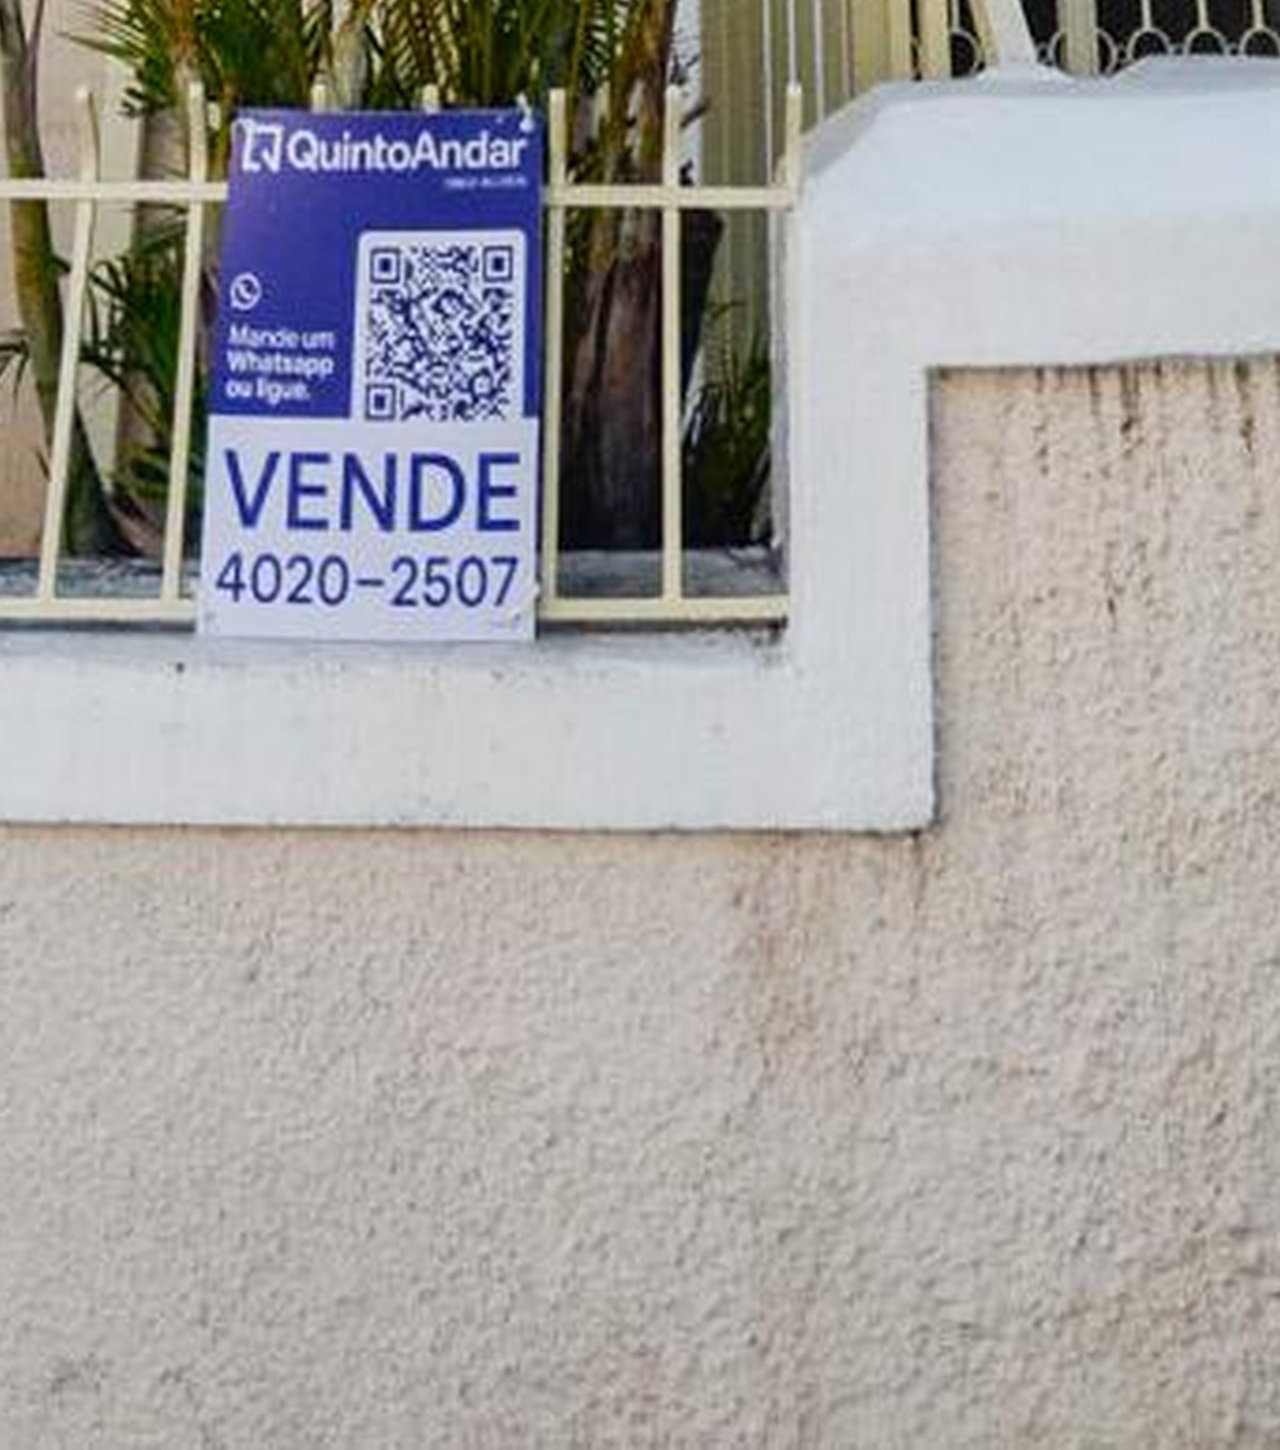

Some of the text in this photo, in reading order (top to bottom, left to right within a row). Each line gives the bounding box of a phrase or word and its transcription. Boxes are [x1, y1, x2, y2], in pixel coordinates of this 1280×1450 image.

[287, 129, 528, 172] QuintoAndar
[228, 323, 335, 350] Mande um
[225, 381, 253, 398] ou
[224, 450, 521, 533] VENDE
[215, 553, 520, 608] 4020-2507
